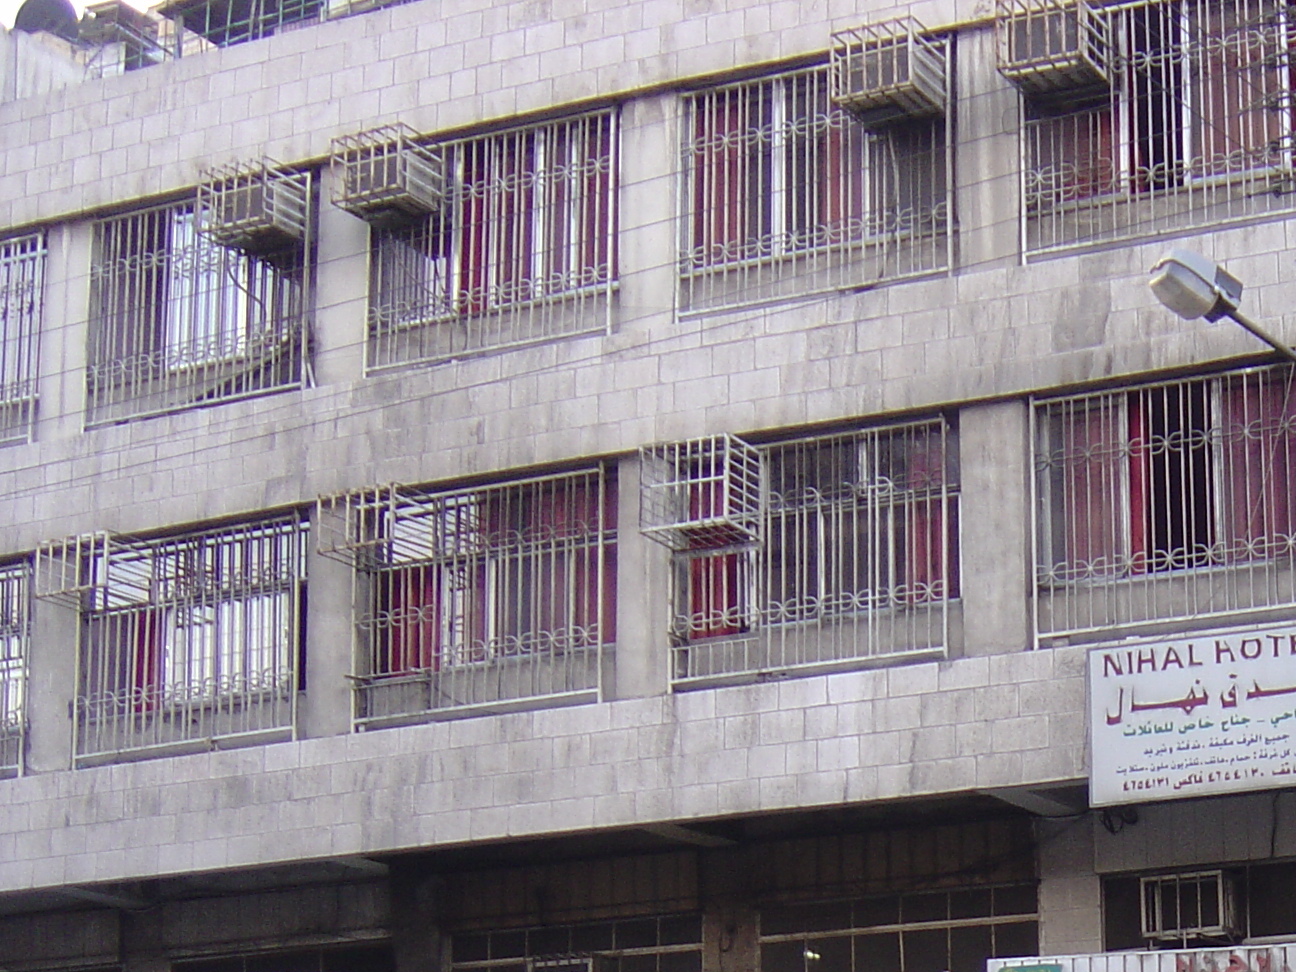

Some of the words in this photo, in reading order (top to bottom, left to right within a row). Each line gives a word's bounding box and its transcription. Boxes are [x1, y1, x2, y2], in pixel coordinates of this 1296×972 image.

[1103, 643, 1203, 678] NIHAL
[1106, 679, 1209, 726] نهال
[1123, 720, 1174, 737] للعائلات
[1178, 718, 1214, 734] خاص
[1221, 716, 1251, 732] جناح
[1173, 770, 1203, 790] فاكس
